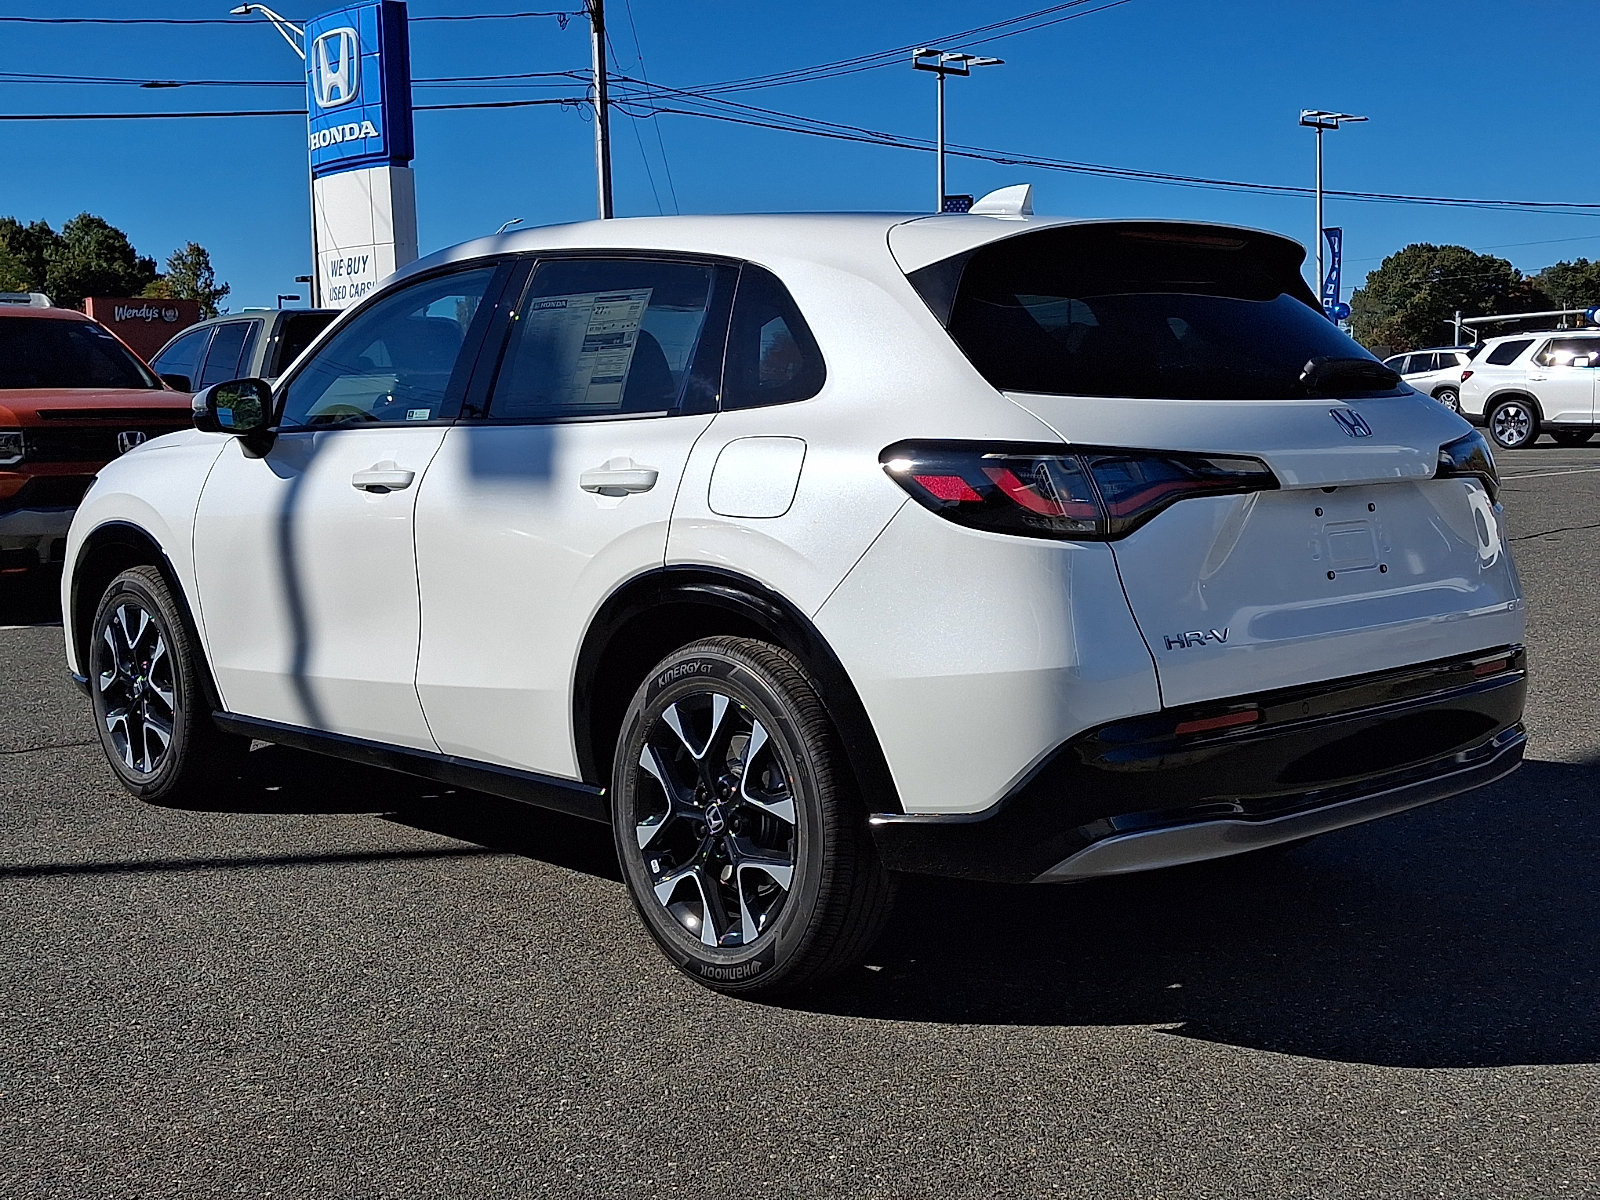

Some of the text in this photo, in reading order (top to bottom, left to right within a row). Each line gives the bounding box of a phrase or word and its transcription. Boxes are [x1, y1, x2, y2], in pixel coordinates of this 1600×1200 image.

[310, 121, 378, 150] HONDA
[330, 255, 369, 278] WE BUY
[329, 285, 347, 302] USED
[114, 304, 159, 322] Wendy's
[1163, 627, 1230, 651] HR-V
[658, 659, 713, 688] KINERGY GT
